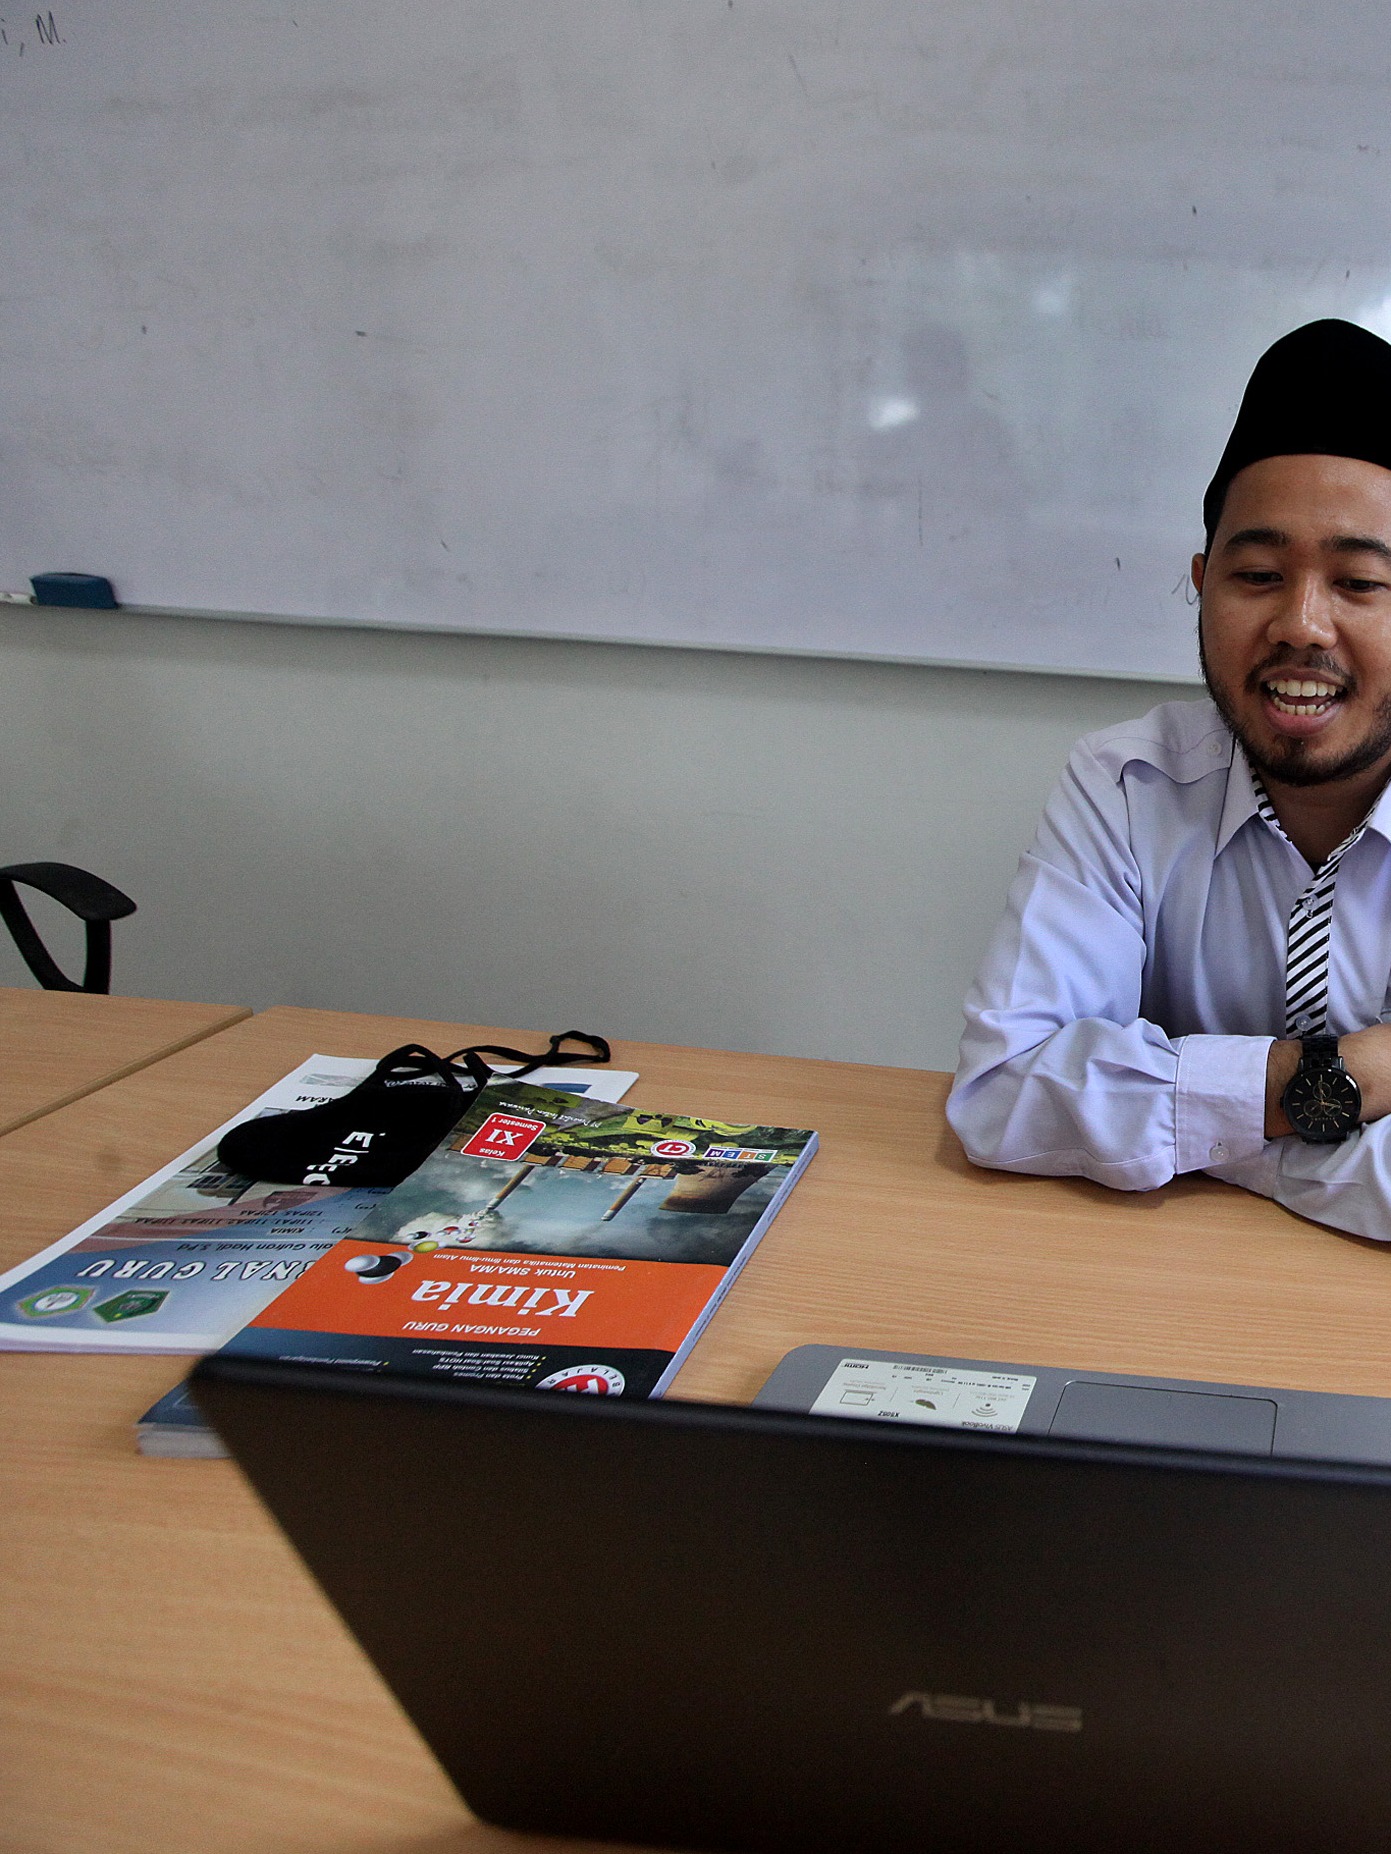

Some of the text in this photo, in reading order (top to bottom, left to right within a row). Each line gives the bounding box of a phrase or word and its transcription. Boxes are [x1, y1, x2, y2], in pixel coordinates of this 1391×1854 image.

[498, 1118, 538, 1131] Semester
[485, 1128, 524, 1146] XI
[479, 1148, 506, 1157] Kelas
[659, 1143, 687, 1153] CT
[711, 1150, 767, 1160] STEM
[309, 1243, 336, 1252] alu
[75, 1258, 206, 1281] GURU
[470, 1264, 576, 1279] Untuk SMA/MA
[523, 1260, 576, 1269] Matematika
[578, 1263, 626, 1271] Peminatan
[410, 1279, 595, 1318] Kimia
[402, 1321, 542, 1337] PEGANGAN GURU
[547, 1367, 621, 1388] BELAJAR
[889, 1691, 1082, 1732] ASUS
